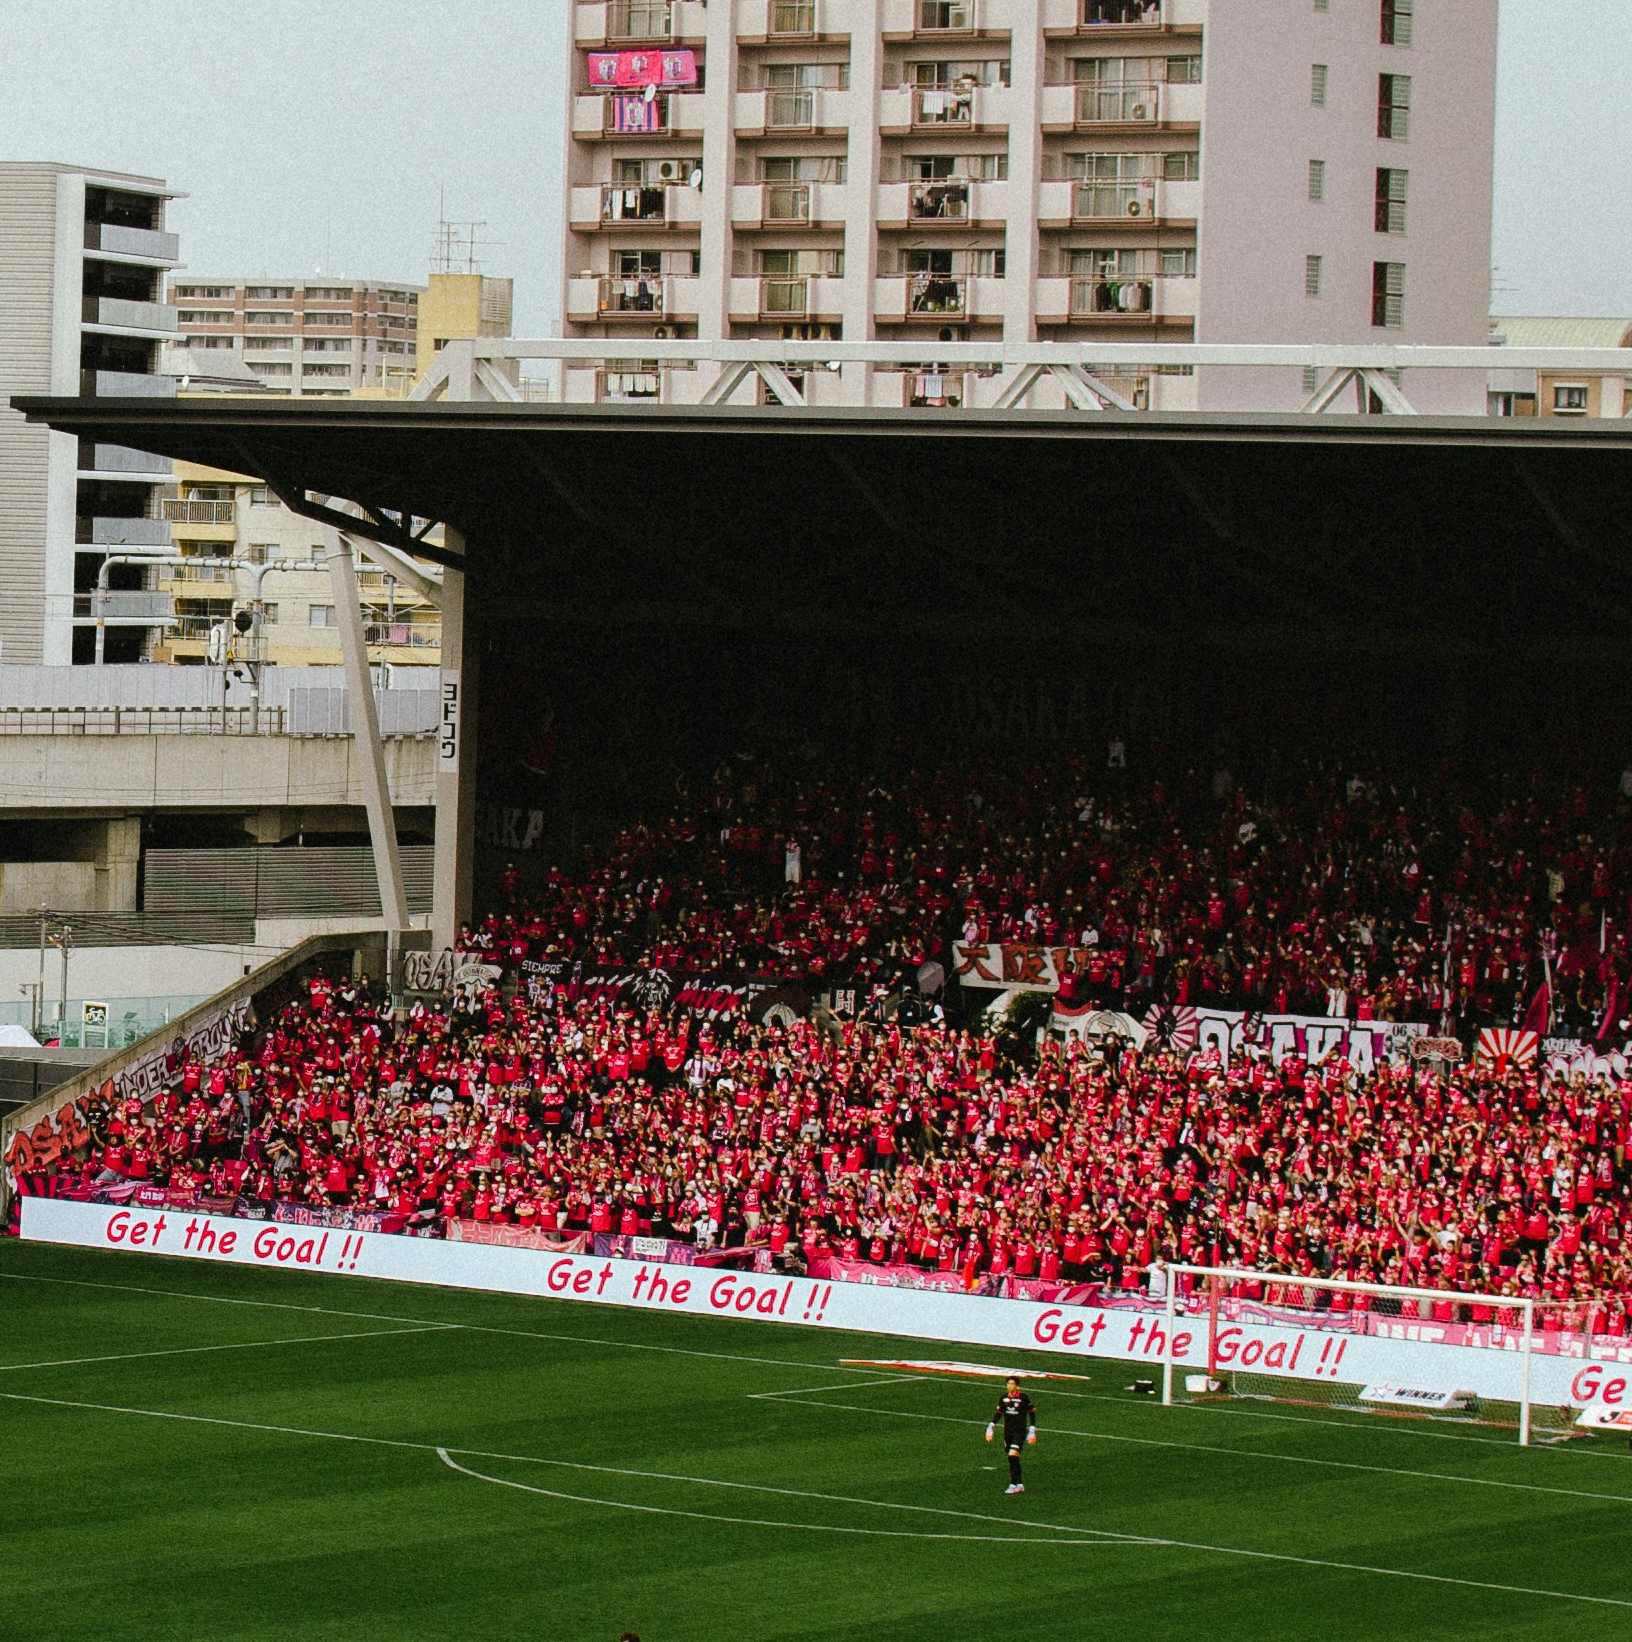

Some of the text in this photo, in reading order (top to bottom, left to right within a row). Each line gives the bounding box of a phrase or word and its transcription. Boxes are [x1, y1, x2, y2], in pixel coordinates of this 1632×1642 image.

[442, 683, 457, 758] ヨドコウ
[106, 1210, 167, 1246] Get
[184, 1218, 237, 1254] the
[254, 1226, 329, 1265] Goal
[338, 1234, 364, 1269] !!
[547, 1258, 613, 1295] Get
[632, 1265, 692, 1304] the
[710, 1275, 794, 1316] Goal
[803, 1283, 832, 1321] !!
[1034, 1308, 1348, 1376] Get the Goal !!
